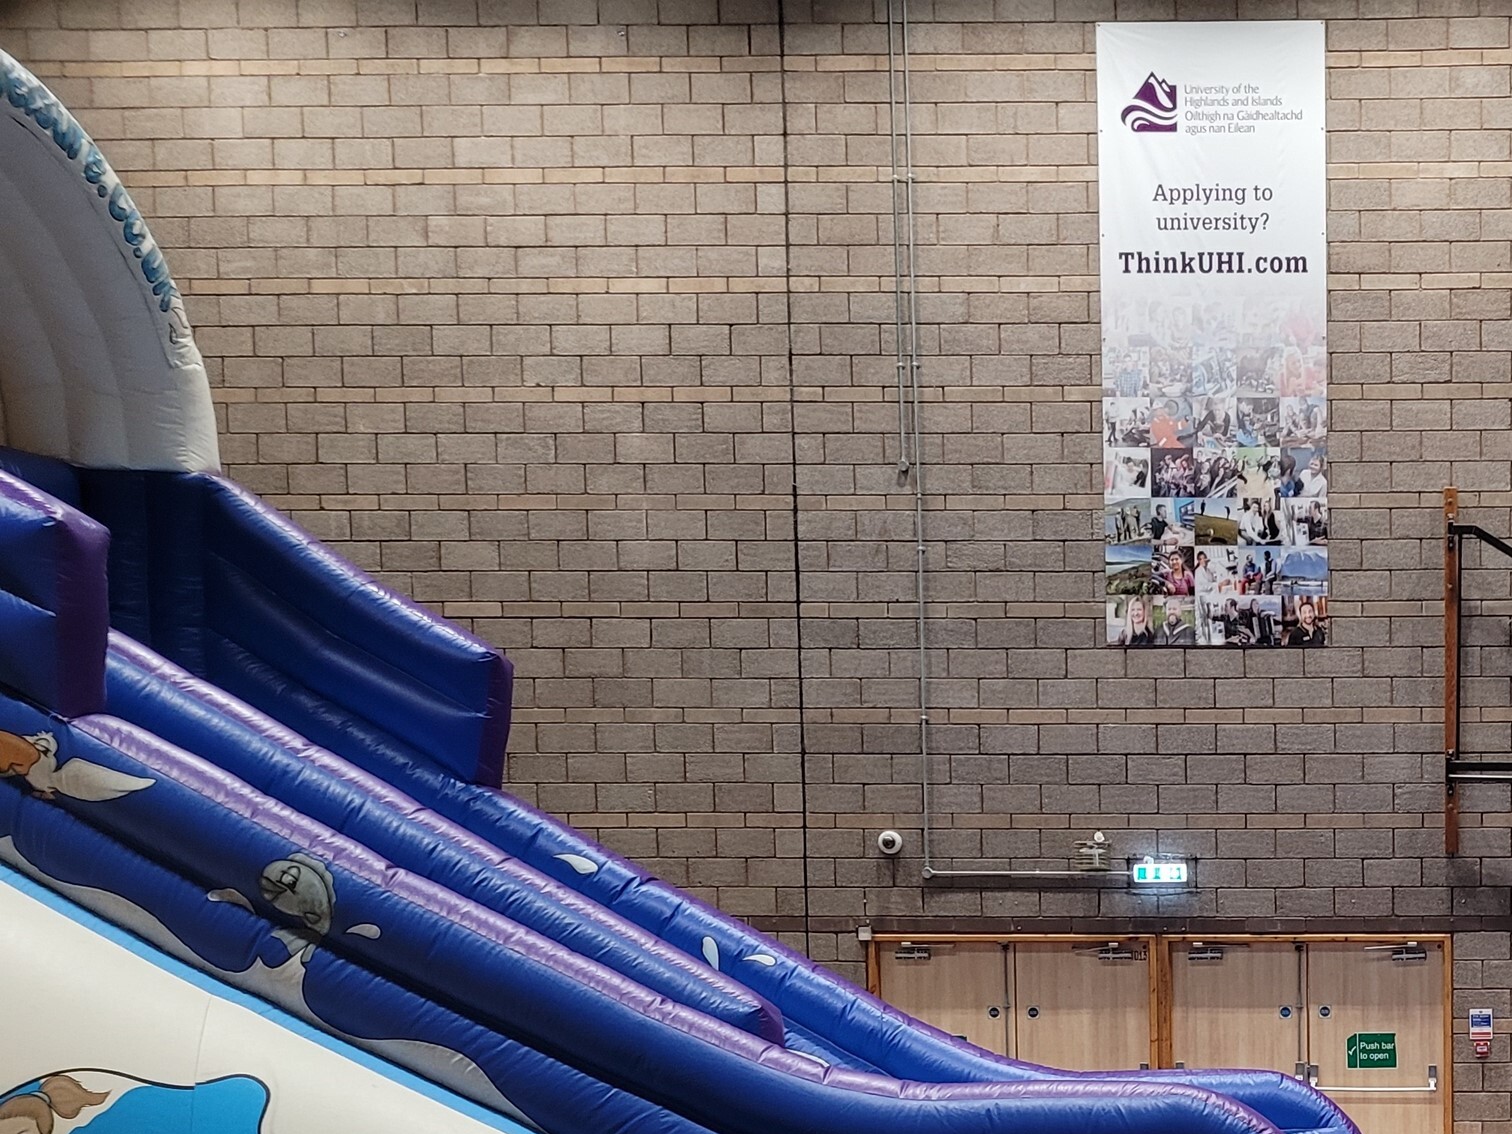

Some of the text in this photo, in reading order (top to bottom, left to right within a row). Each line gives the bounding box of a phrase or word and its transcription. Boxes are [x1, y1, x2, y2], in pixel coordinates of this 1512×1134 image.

[1184, 83, 1259, 96] University of the
[1184, 96, 1282, 109] Highlands and Islands
[1184, 110, 1221, 123] Oilthigh
[1223, 112, 1234, 121] na
[1185, 123, 1255, 136] agus nan Eilean
[1152, 183, 1273, 205] Applying to
[1156, 212, 1270, 234] university?
[1118, 250, 1308, 274] ThinkUHI.com
[1360, 1041, 1395, 1050] Push bar
[1360, 1052, 1389, 1061] to open
